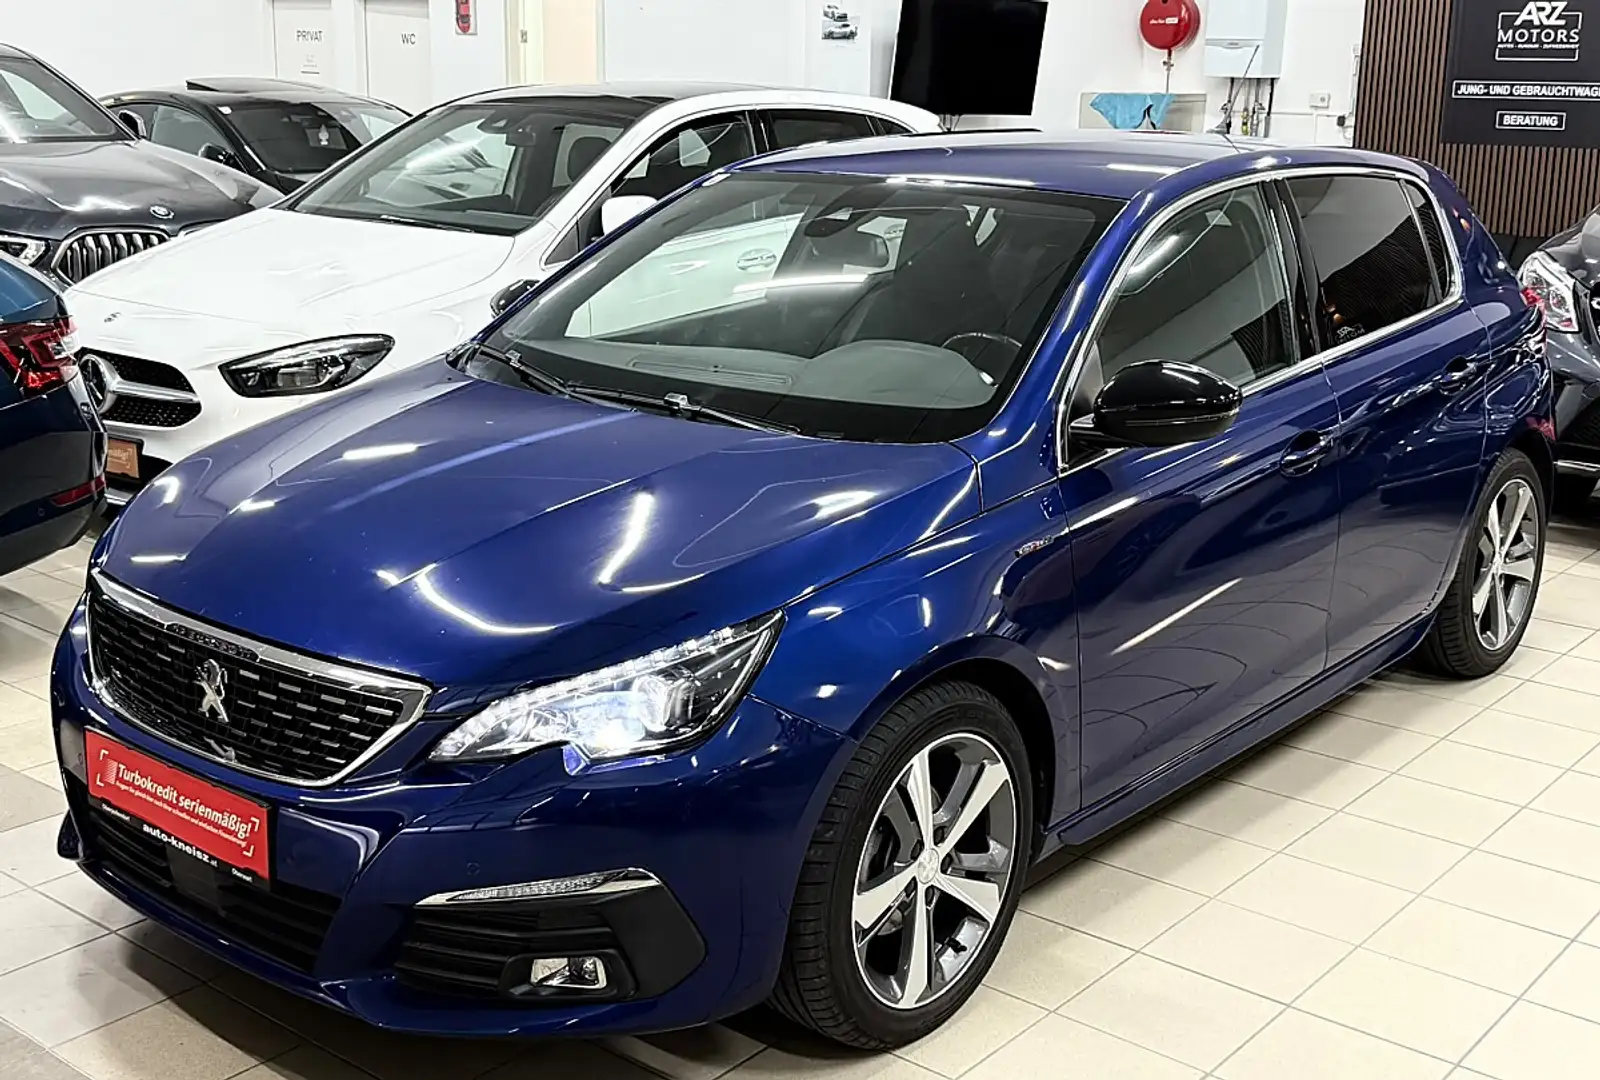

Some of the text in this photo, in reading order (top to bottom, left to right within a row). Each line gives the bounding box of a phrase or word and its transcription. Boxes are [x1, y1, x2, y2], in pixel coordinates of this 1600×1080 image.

[1513, 1, 1568, 26] ARZ
[296, 30, 323, 42] PRIVAT
[401, 33, 416, 45] WC
[1497, 28, 1580, 43] MOTORS
[1457, 84, 1488, 95] JUNG-
[1489, 85, 1511, 95] UND
[1503, 114, 1559, 127] BERATUNG
[118, 763, 178, 804] Turbokredit
[178, 795, 252, 839] serienmäßig!
